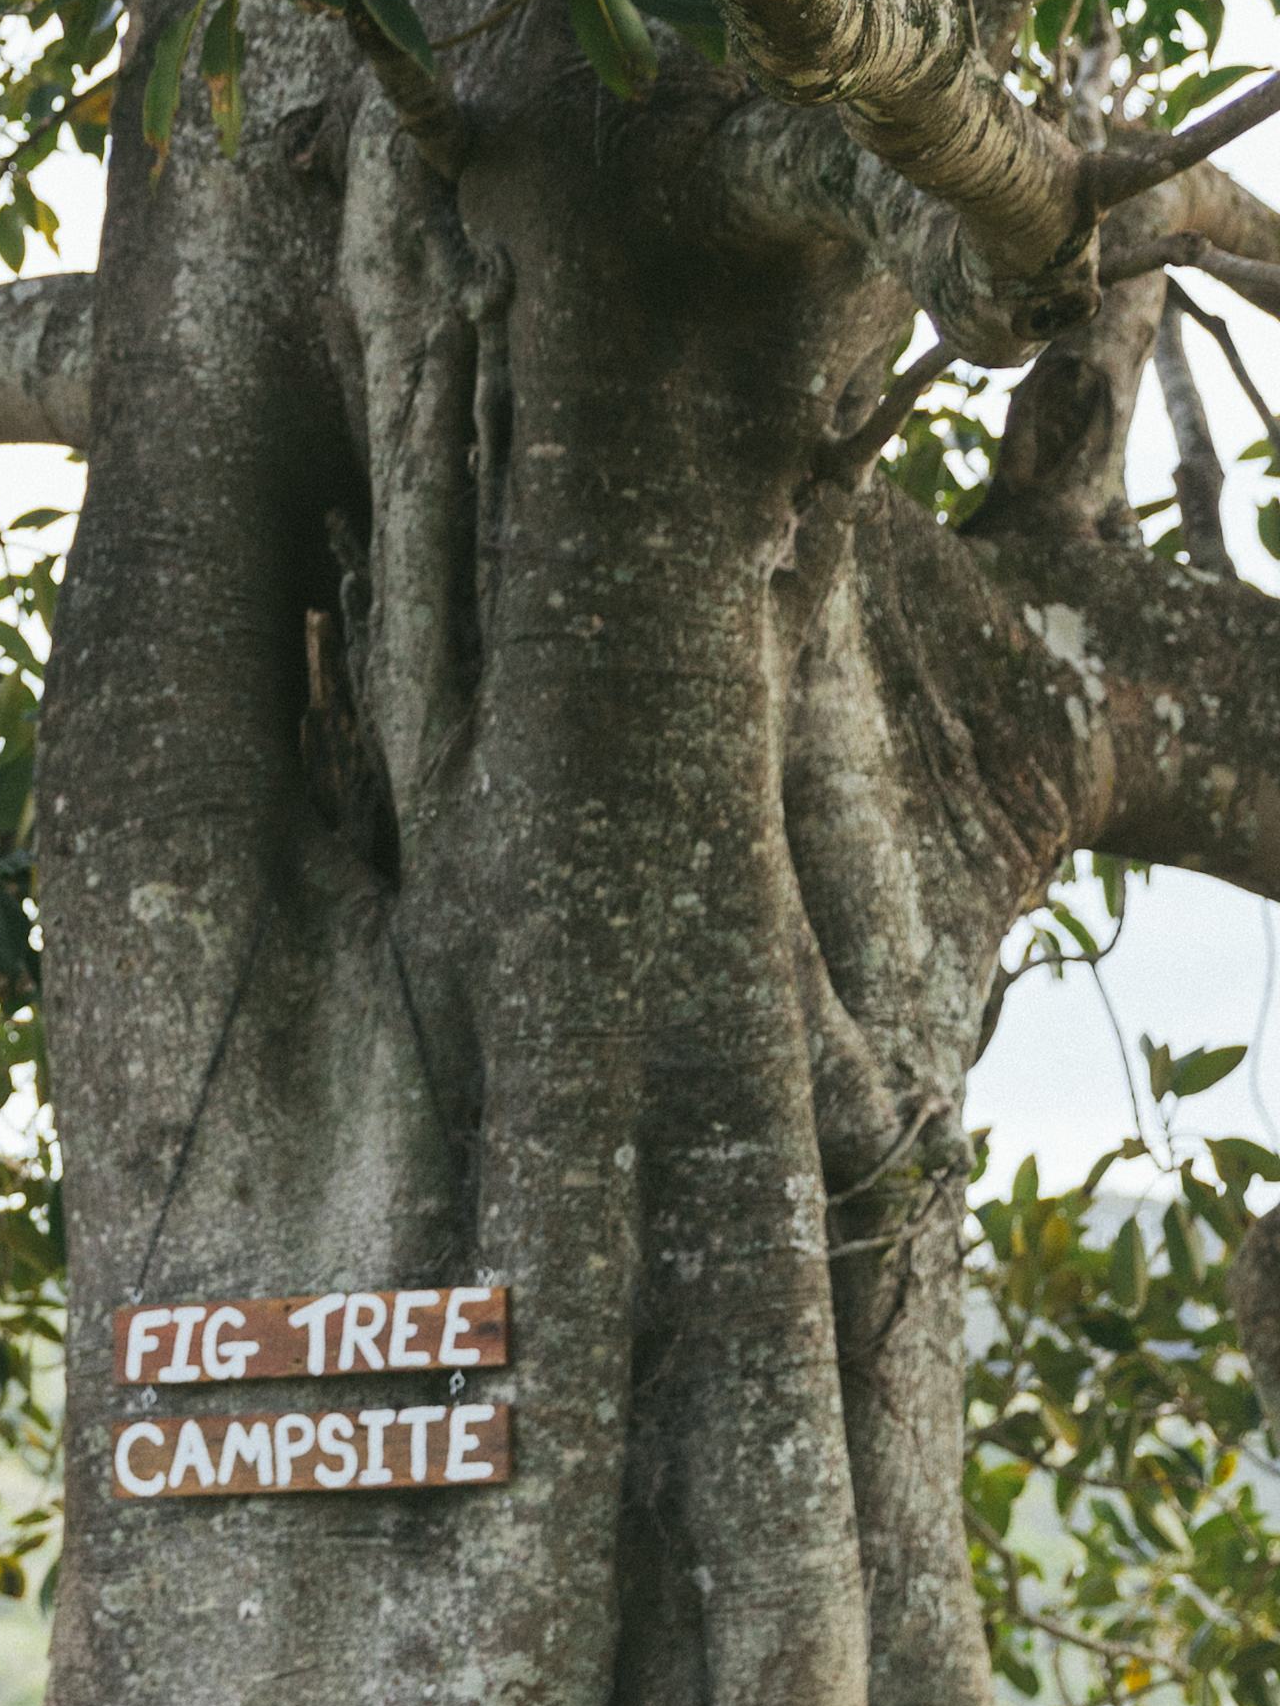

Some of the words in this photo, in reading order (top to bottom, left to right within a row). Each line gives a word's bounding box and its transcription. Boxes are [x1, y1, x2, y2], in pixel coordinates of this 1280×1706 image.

[125, 1306, 259, 1383] FIG
[288, 1287, 491, 1376] TREE
[114, 1404, 495, 1496] CAMPSITE
